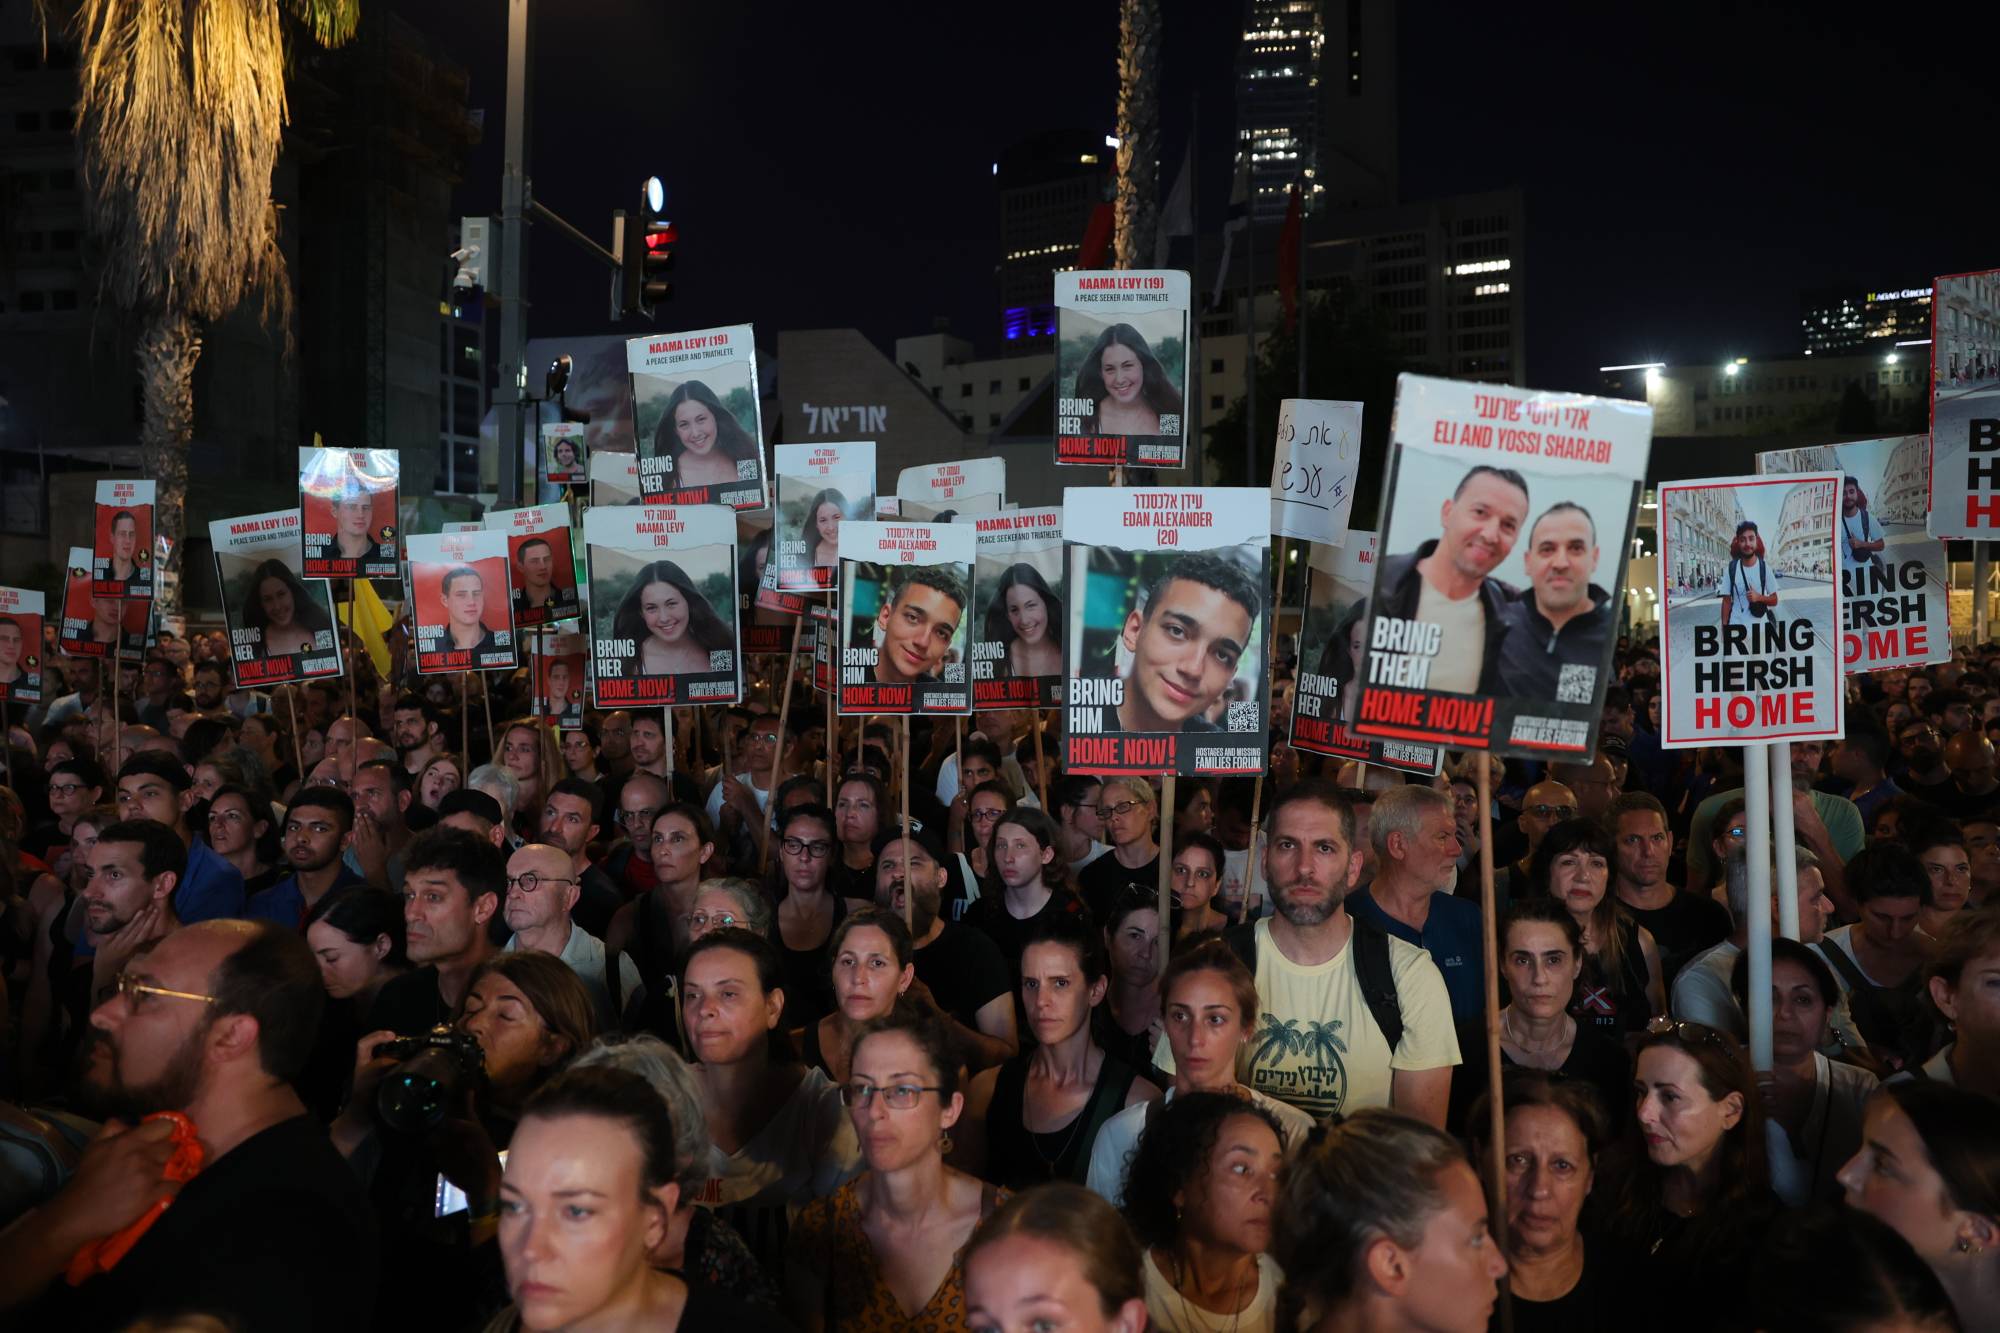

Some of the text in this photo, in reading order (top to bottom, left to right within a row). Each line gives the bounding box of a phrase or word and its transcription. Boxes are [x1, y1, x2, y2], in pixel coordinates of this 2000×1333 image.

[1079, 277, 1164, 289] NAAMA LEVY (19)
[649, 334, 728, 354] NAAMA LEVY (19)
[651, 357, 668, 365] PEACE
[669, 354, 689, 363] SEEKER
[690, 353, 701, 361] AND
[703, 348, 733, 359] TRIATHLETE
[1059, 398, 1094, 416] BRING
[1474, 395, 1521, 422] שרעבי
[802, 402, 887, 434] אריאל
[1059, 417, 1080, 434] HER
[1566, 406, 1590, 432] אלי
[1277, 414, 1332, 445] את כול
[1059, 437, 1126, 456] HOME NOW!
[1434, 421, 1612, 464] ELI AND YOSSI SHARABI
[641, 455, 673, 475] BRING
[641, 474, 663, 493] HER
[931, 476, 965, 488] NAAMA LEVY
[1279, 459, 1322, 498] עכשי
[644, 486, 709, 504] HOME NOW!
[1133, 494, 1203, 510] עידן אלכסנדר
[644, 509, 676, 521] נעמה לוי
[976, 514, 1057, 531] NAAMA LEVY (19)
[1123, 512, 1213, 527] EDAN ALEXANDER
[230, 515, 299, 536] NAAMA LEVY (19)
[277, 529, 301, 540] TRIATHLET
[636, 522, 684, 534] NAAMA LEVY
[886, 528, 931, 540] עידן אלכסנדר
[305, 533, 332, 546] BRING
[654, 534, 668, 546] (19)
[879, 540, 937, 551] EDAN ALEXANDER
[977, 529, 1063, 544] PEACE SEEKER AND TRIATHLETE
[1157, 529, 1178, 546] (20)
[305, 546, 322, 559] HIM
[780, 541, 806, 554] BRING
[901, 551, 915, 562] (20)
[305, 559, 357, 573] HOME NOW!
[780, 554, 797, 568] HER
[807, 566, 832, 583] NOW!
[1843, 561, 1926, 597] RING
[1843, 594, 1926, 630] ERSH
[63, 617, 88, 630] BRING
[418, 625, 444, 638] BRING
[62, 628, 78, 640] HIM
[232, 627, 261, 645] BRING
[1372, 616, 1443, 656] BRING
[1694, 619, 1814, 657] BRING
[234, 644, 254, 661] HER
[419, 639, 436, 652] HIM
[597, 639, 635, 658] BRING
[972, 641, 1005, 660] BRING
[1844, 626, 1929, 664] OME
[420, 653, 445, 667] HOME
[447, 651, 472, 665] NOW!
[843, 648, 879, 666] BRING
[238, 661, 265, 679] HOME
[266, 655, 294, 675] NOW!
[598, 659, 622, 677] HER
[843, 667, 864, 685] HIM
[972, 662, 994, 679] HER
[1369, 651, 1431, 689] THEM
[1695, 656, 1814, 693] HERSH
[599, 675, 675, 698] HOME NOW!
[689, 687, 735, 697] FAMILIES FORUM
[974, 681, 1007, 700] HOME
[1008, 679, 1040, 699] NOW!
[1069, 679, 1124, 706] BRING
[1300, 672, 1338, 698] BRING
[843, 685, 912, 704] HOME NOW!
[923, 698, 966, 707] FAMILIES FORUM
[1297, 695, 1321, 717] HER
[1361, 688, 1494, 735] HOME NOW!
[1695, 692, 1815, 729] HOME
[1069, 707, 1103, 733] HIM
[1295, 718, 1329, 743] HOME
[1511, 726, 1588, 746] FAMILIES FORUM
[1069, 736, 1176, 765] HOME NOW!
[1196, 748, 1261, 757] HOSTAGES AND MISSING
[1383, 748, 1433, 766] FAMILIES FORUM
[1195, 757, 1261, 769] FAMILIES FORUM
[1255, 1065, 1338, 1086] קיבוץ נירים
